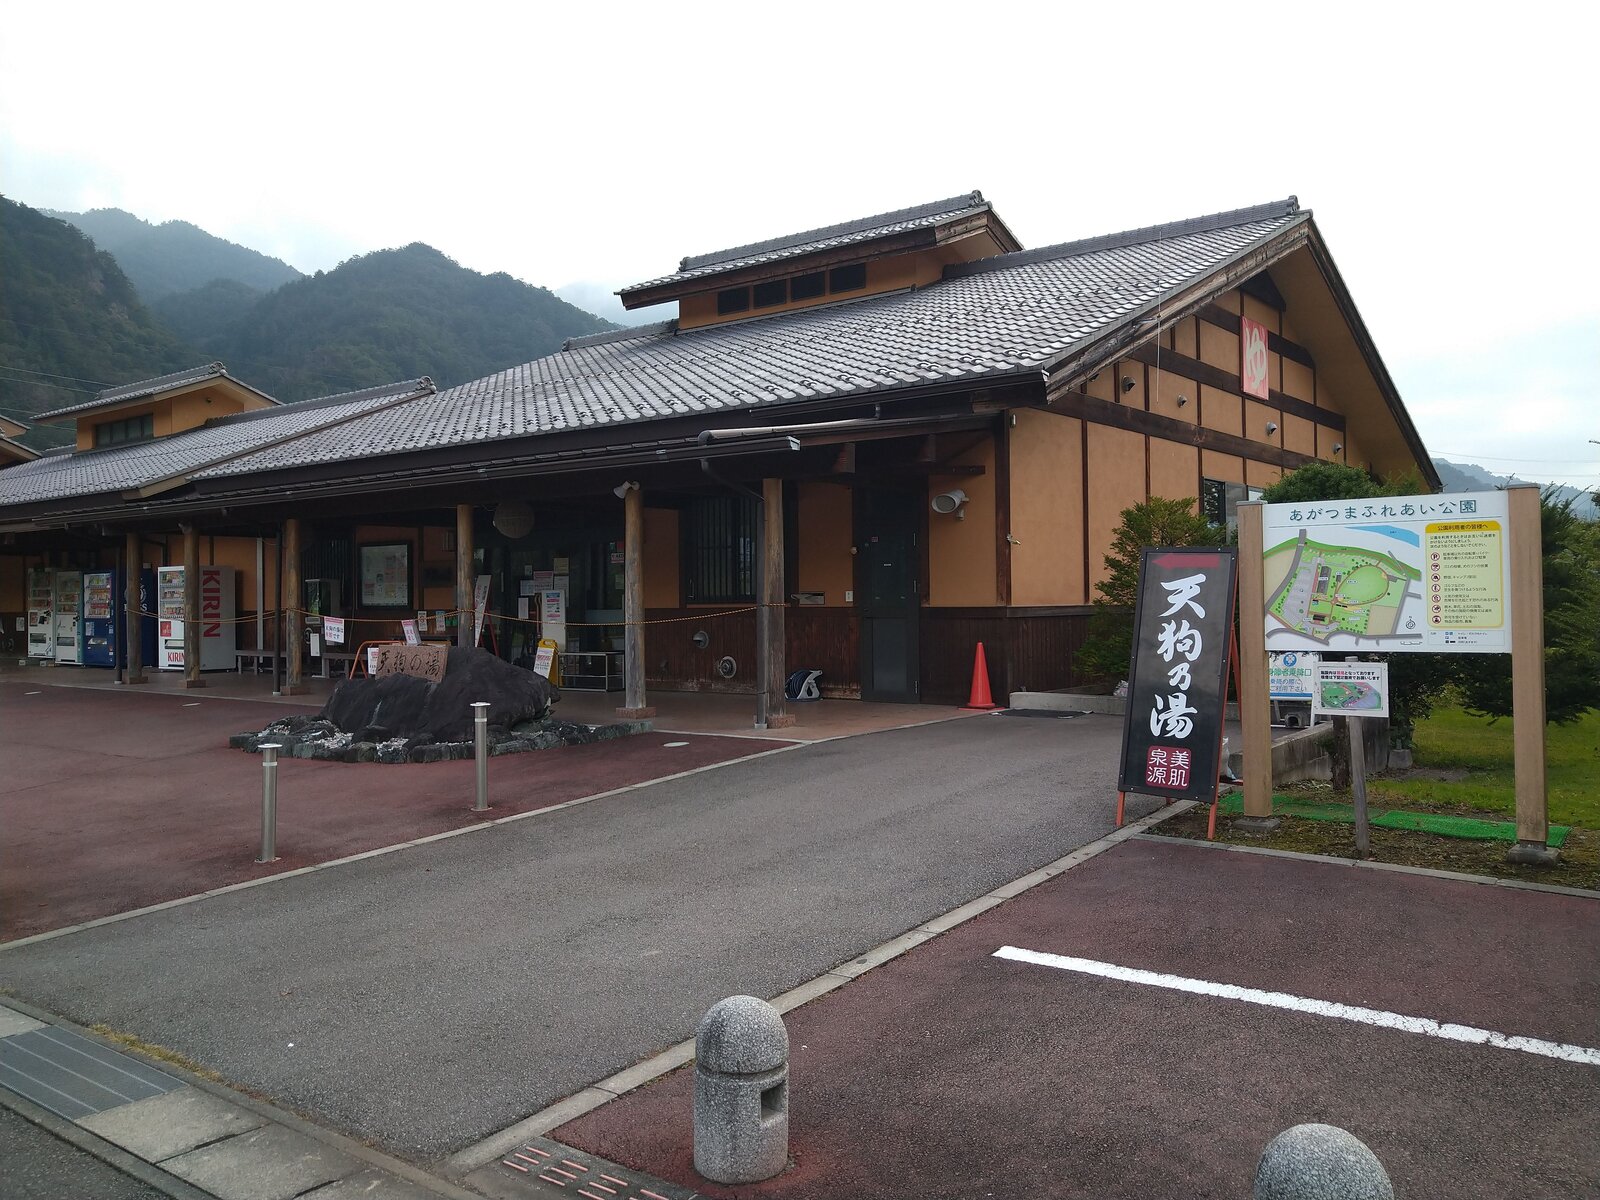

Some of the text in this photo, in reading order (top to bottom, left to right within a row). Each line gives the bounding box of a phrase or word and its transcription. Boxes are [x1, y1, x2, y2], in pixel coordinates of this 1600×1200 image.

[1245, 327, 1267, 389] ゆ
[1289, 500, 1477, 522] あがつまふれあい公園
[203, 570, 220, 638] KIRIN
[1150, 574, 1206, 739] 天狗乃湯
[1147, 748, 1168, 785] 泉源
[1168, 750, 1190, 787] 美肌
